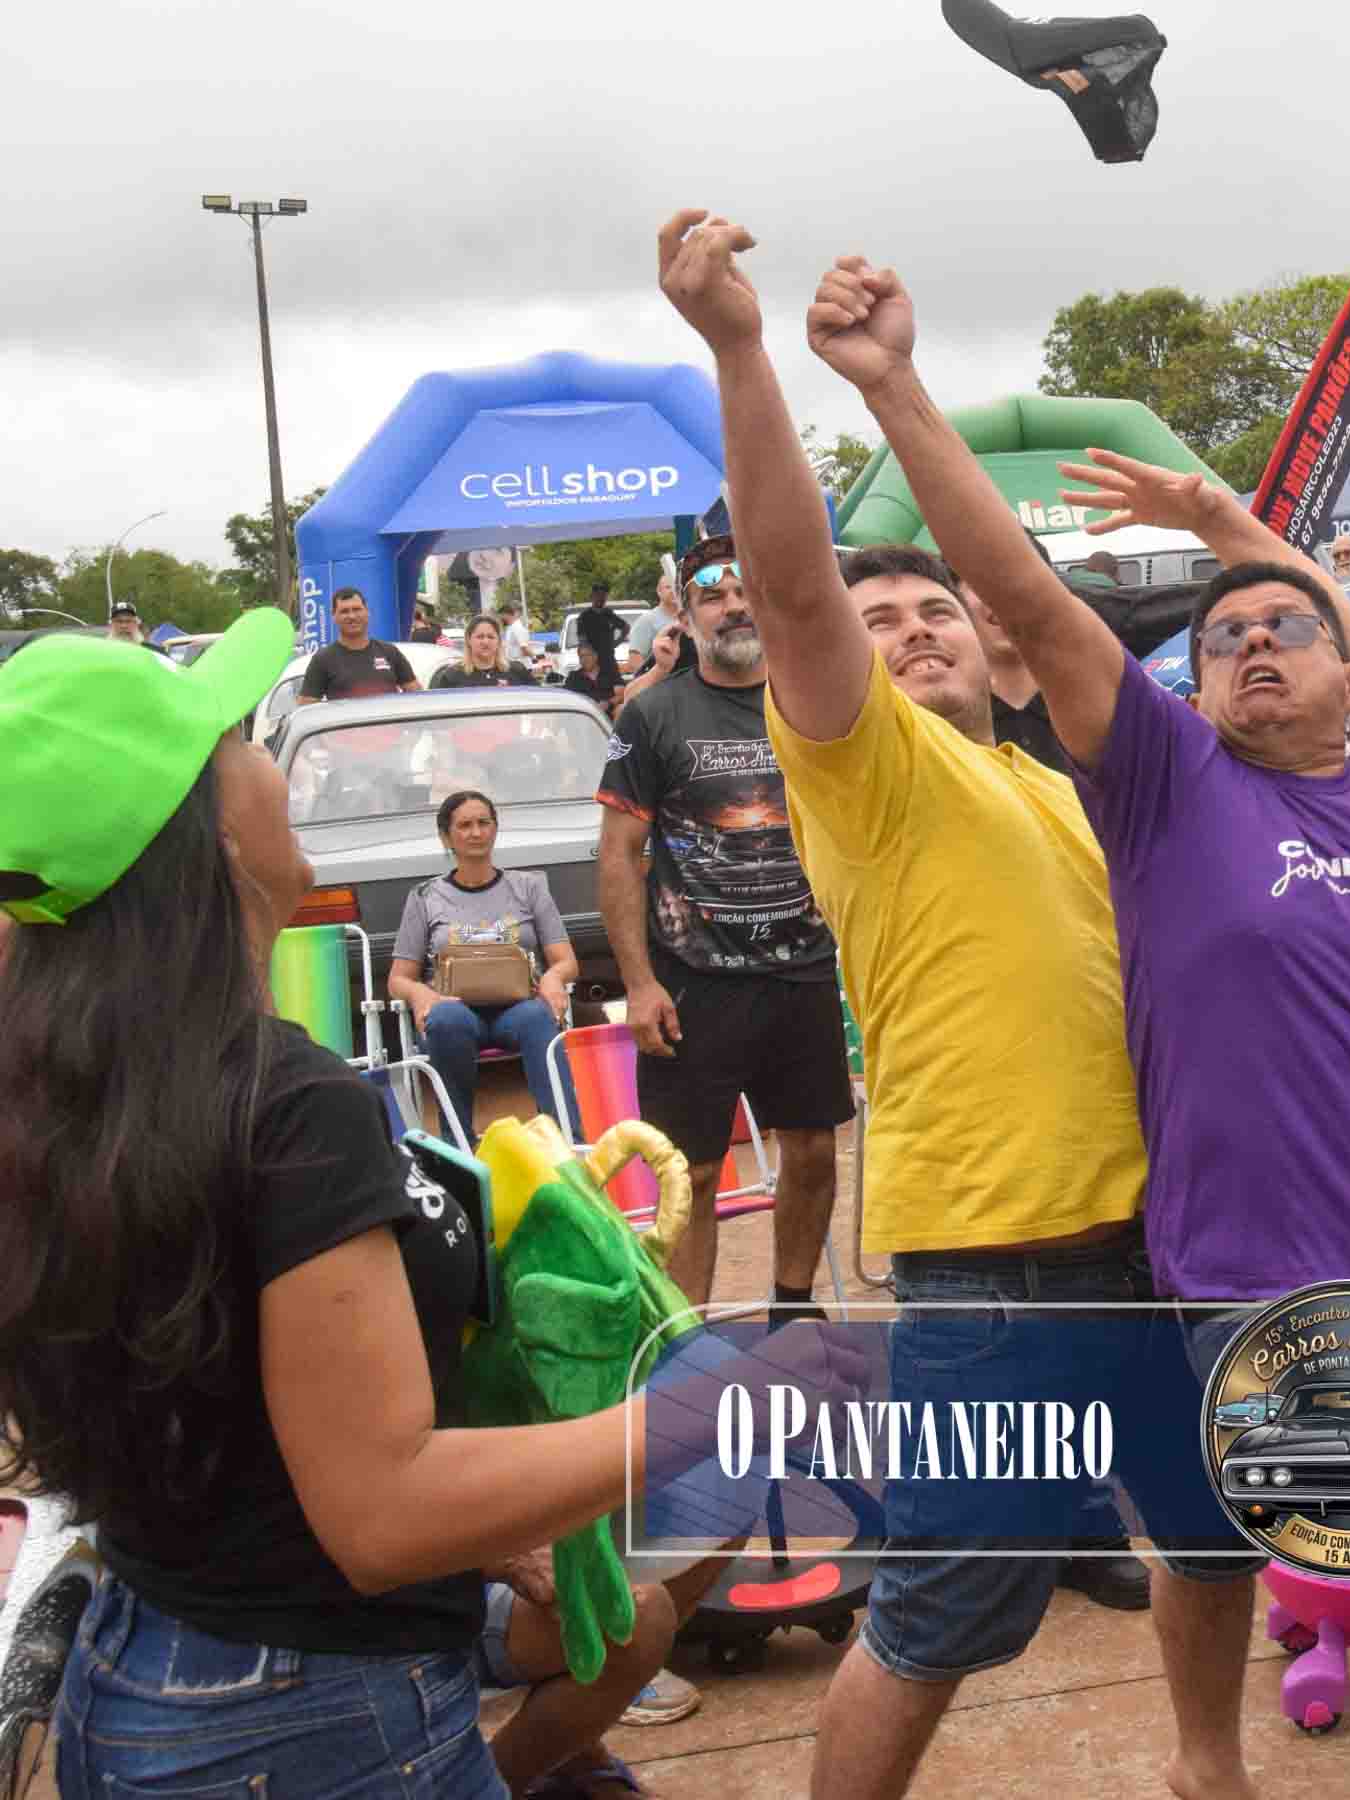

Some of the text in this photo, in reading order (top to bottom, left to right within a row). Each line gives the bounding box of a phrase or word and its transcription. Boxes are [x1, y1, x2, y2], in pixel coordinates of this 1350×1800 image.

[460, 463, 679, 499] cellshop
[1288, 415, 1342, 544] HOSAIRCOLED23
[1301, 519, 1313, 545] 67
